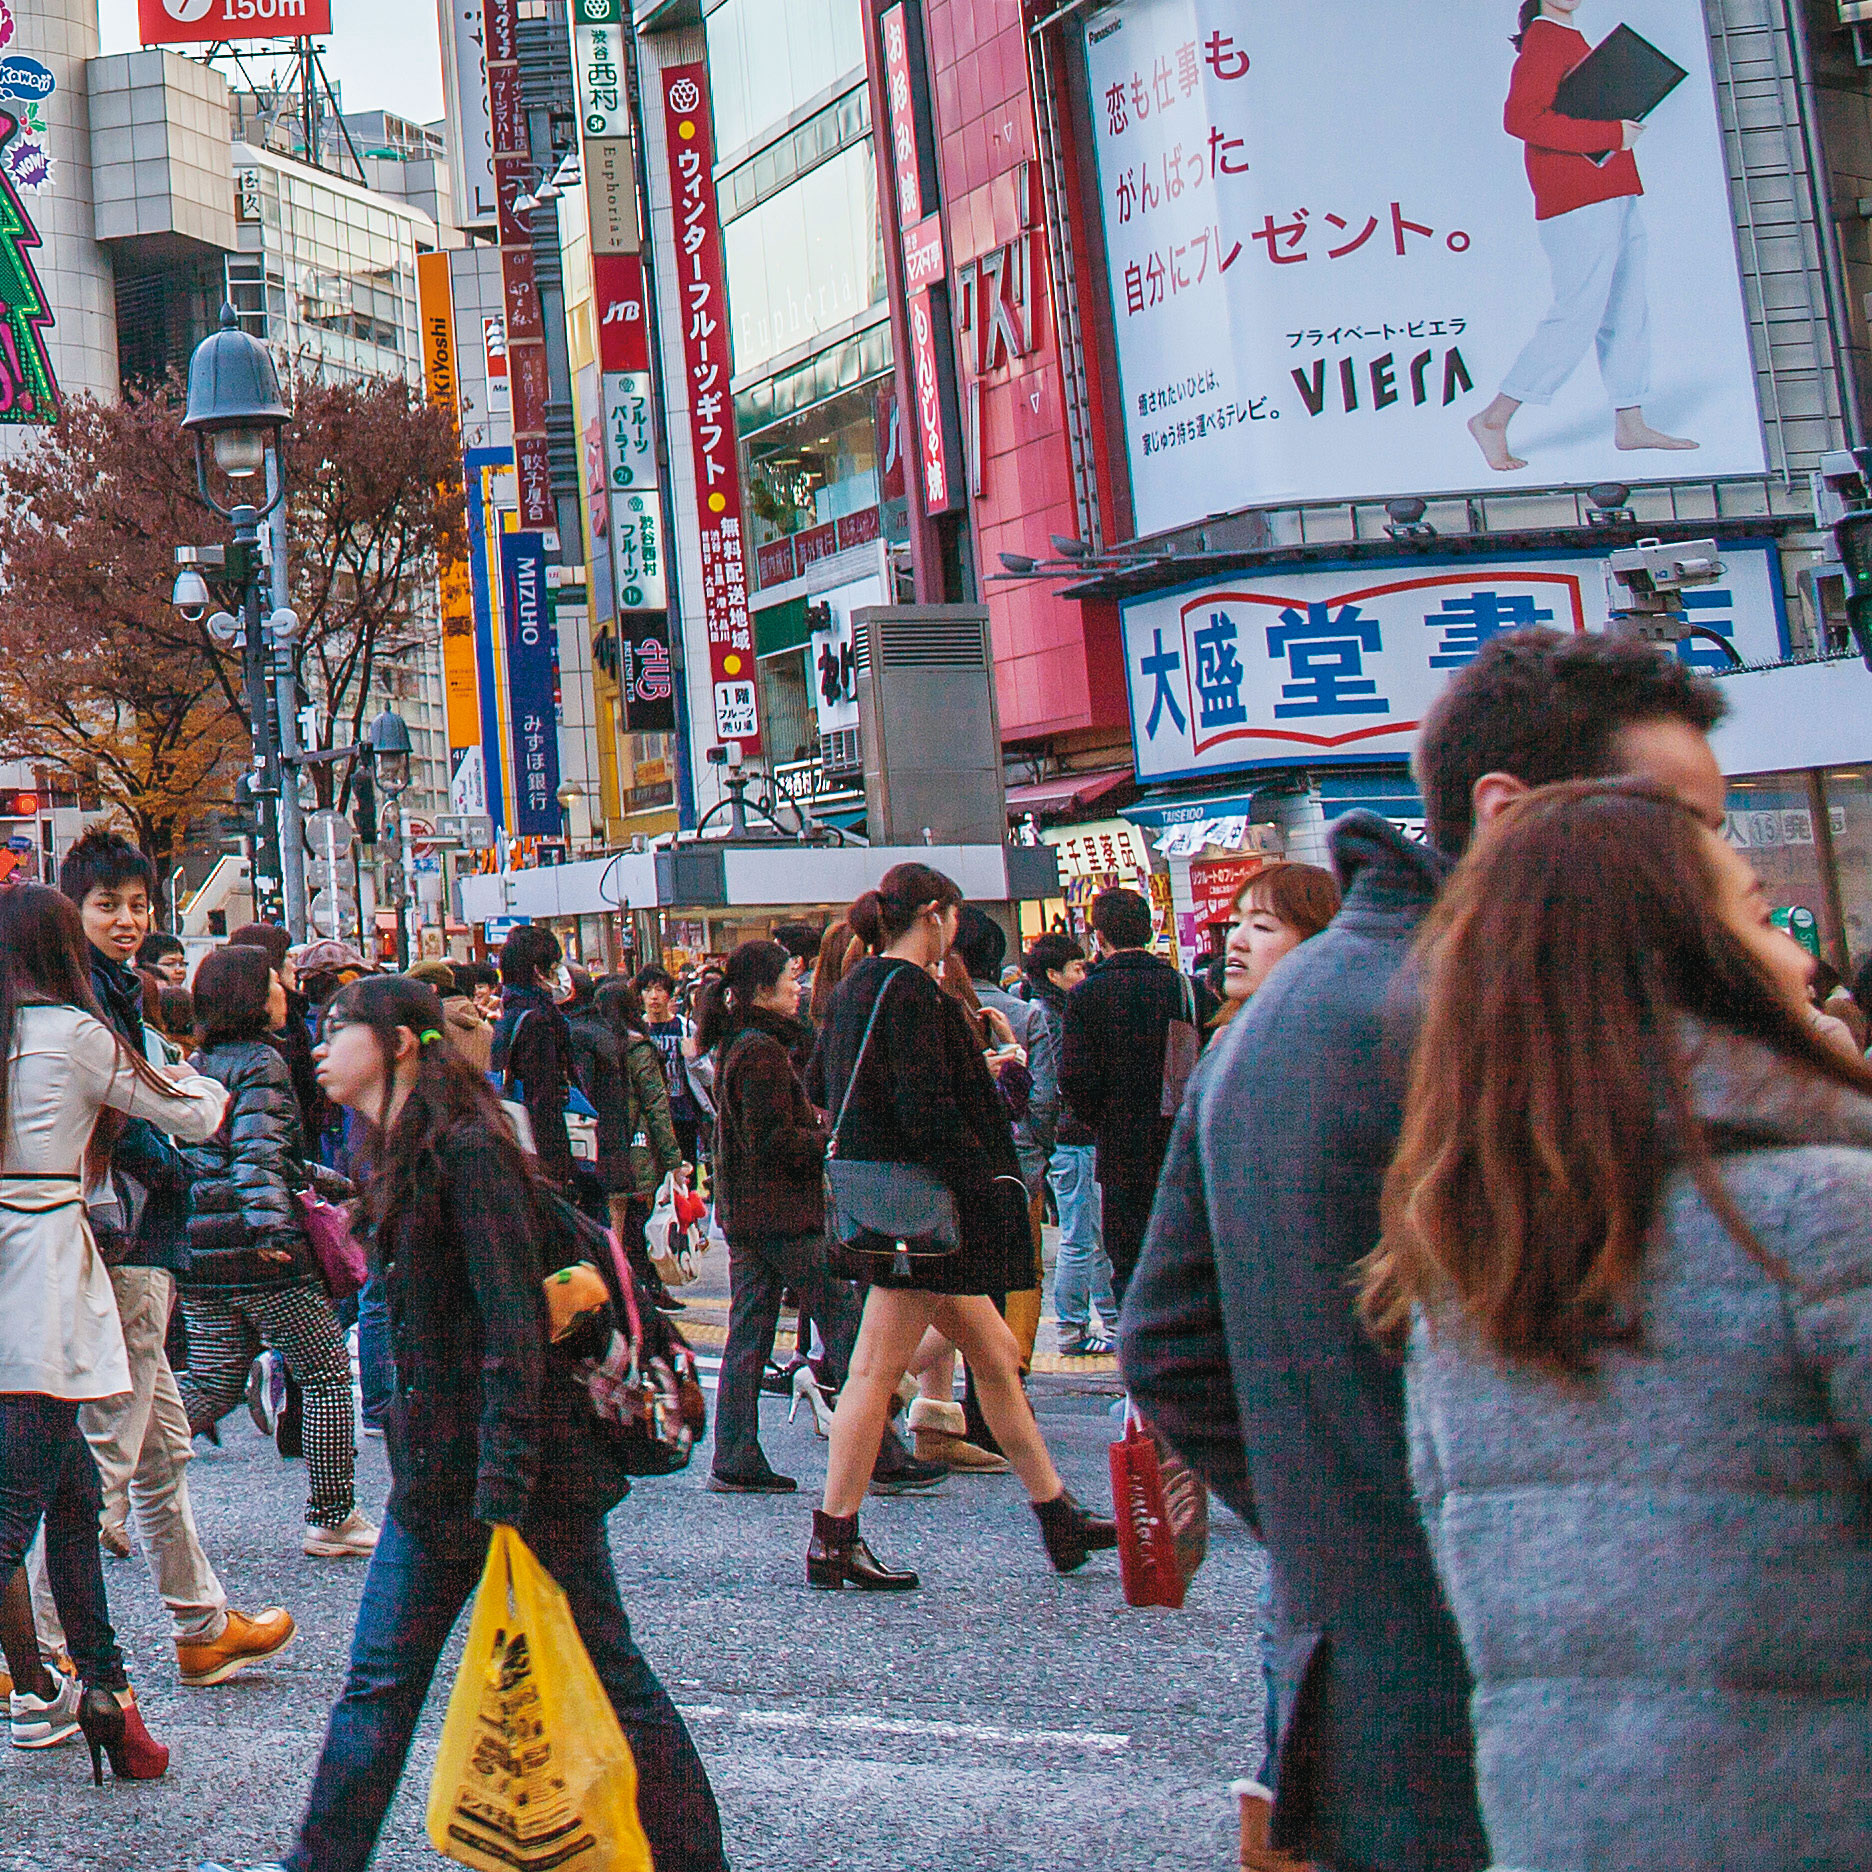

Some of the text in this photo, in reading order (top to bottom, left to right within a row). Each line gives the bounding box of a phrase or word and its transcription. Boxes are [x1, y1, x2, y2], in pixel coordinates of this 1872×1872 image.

[1087, 17, 1124, 47] Panasonic
[587, 29, 618, 111] 渋谷西村
[1105, 28, 1251, 139] 恋も仕事も
[590, 117, 605, 131] 5F
[887, 21, 919, 212] お好み焼
[14, 151, 49, 182] WOW!
[602, 146, 620, 235] Euphoria
[1115, 125, 1250, 227] がんばった
[1122, 201, 1471, 319] 自分にプレゼント。
[603, 300, 641, 325] JTB
[677, 149, 727, 487] ウィンターフルーツギフト
[1285, 317, 1468, 350] プライベート・ビエラ
[912, 298, 944, 502] もんじゃ焼
[1138, 369, 1222, 419] 癒されたいひとは、
[1290, 345, 1474, 419] VIERA
[611, 404, 630, 463] パーラー
[631, 395, 650, 454] フルーツ
[1141, 397, 1282, 458] 家じゅう持ち運べるテレビ。
[621, 524, 639, 584] フルーツ
[640, 515, 659, 577] 渋谷西村
[517, 556, 539, 647] MIZUHO
[720, 516, 752, 652] 無料配送地域
[639, 638, 673, 702] HUB
[720, 687, 751, 708] 1階
[523, 715, 547, 811] みずほ銀行
[1161, 807, 1204, 825] TAISEIDO
